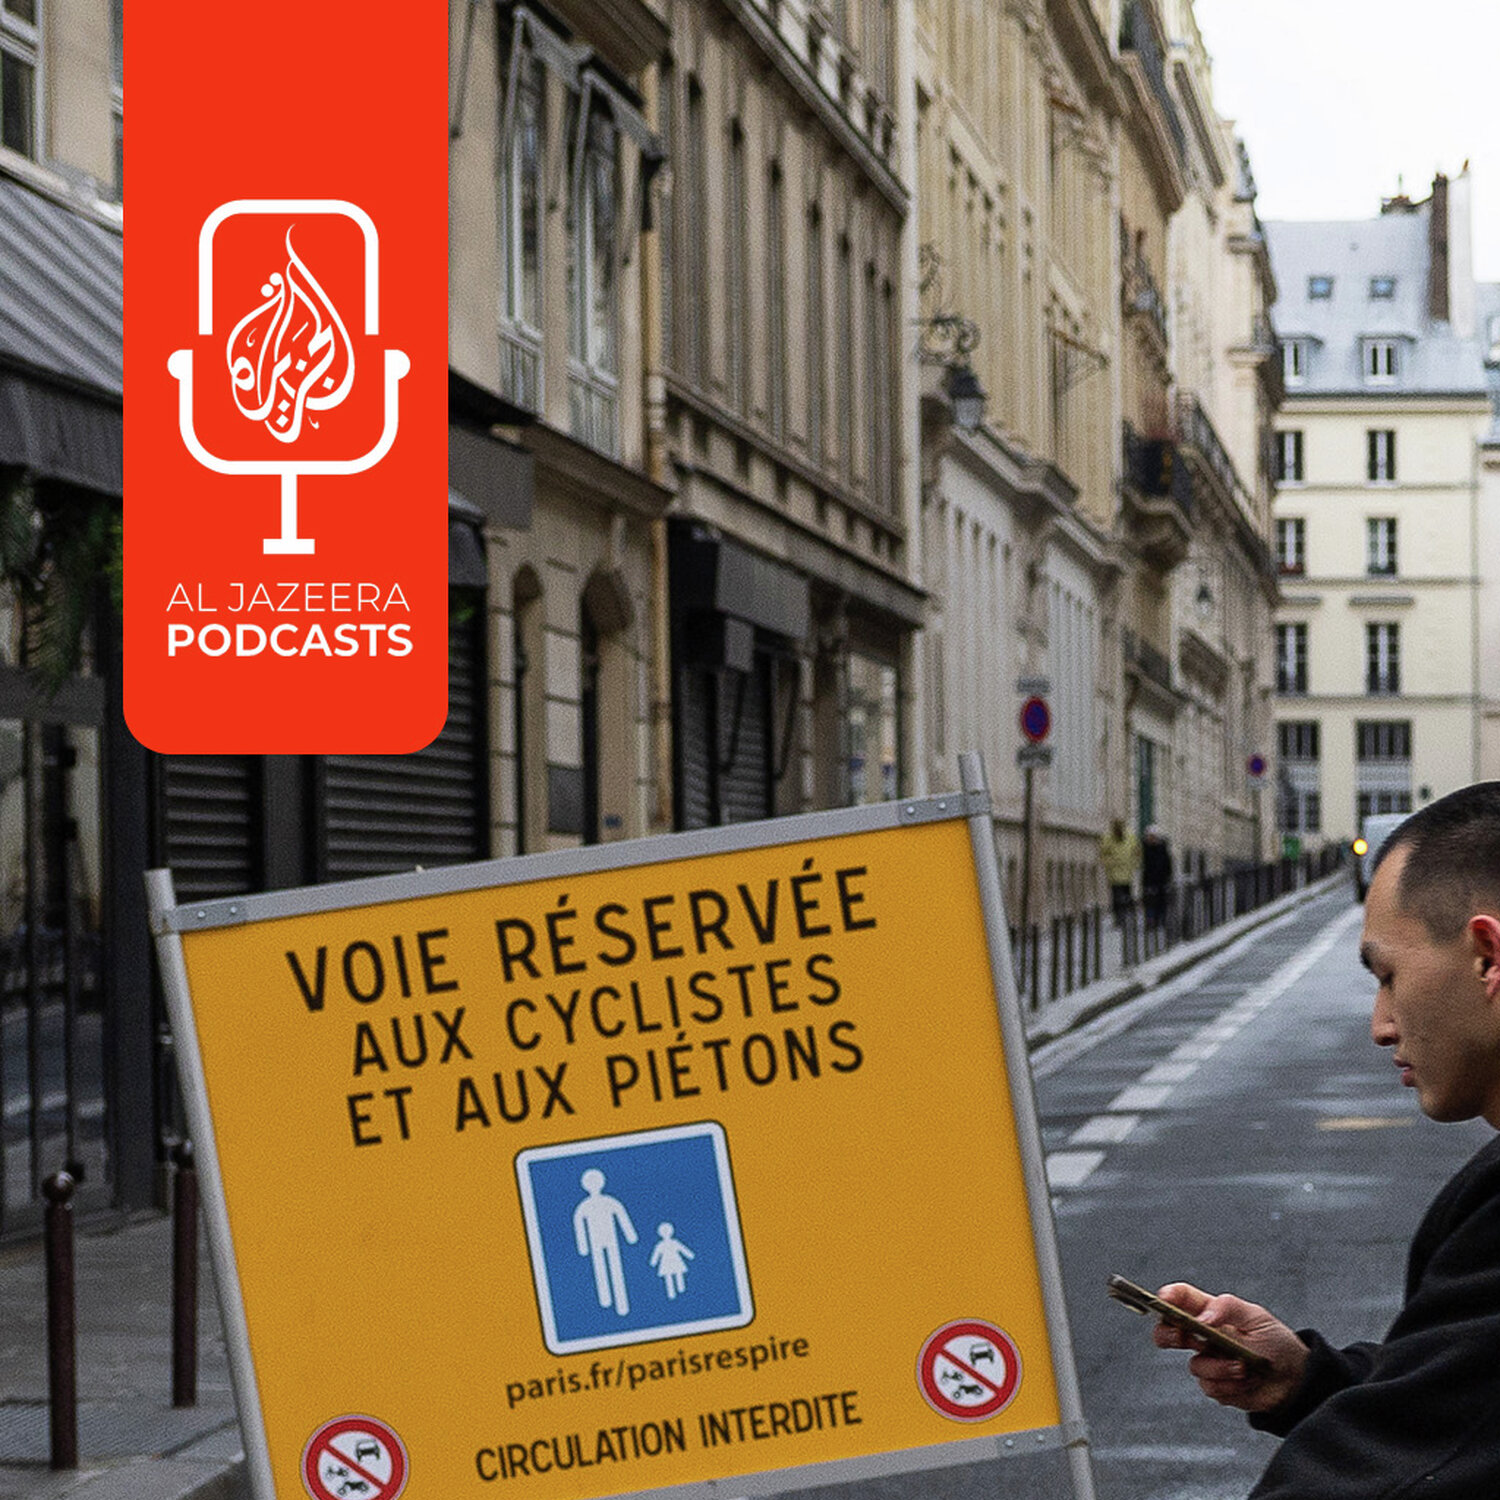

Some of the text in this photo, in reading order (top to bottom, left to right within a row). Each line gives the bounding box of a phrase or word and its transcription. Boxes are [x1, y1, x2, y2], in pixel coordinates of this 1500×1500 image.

[285, 857, 877, 1013] VOIE RÉSERVÉE
[353, 953, 841, 1077] AUX CYCLISTES
[346, 1020, 864, 1147] ET AUX PIÉTONS
[506, 1337, 810, 1409] paris.fr/parisrespire
[475, 1390, 863, 1482] CIRCULATION INTERDITE
